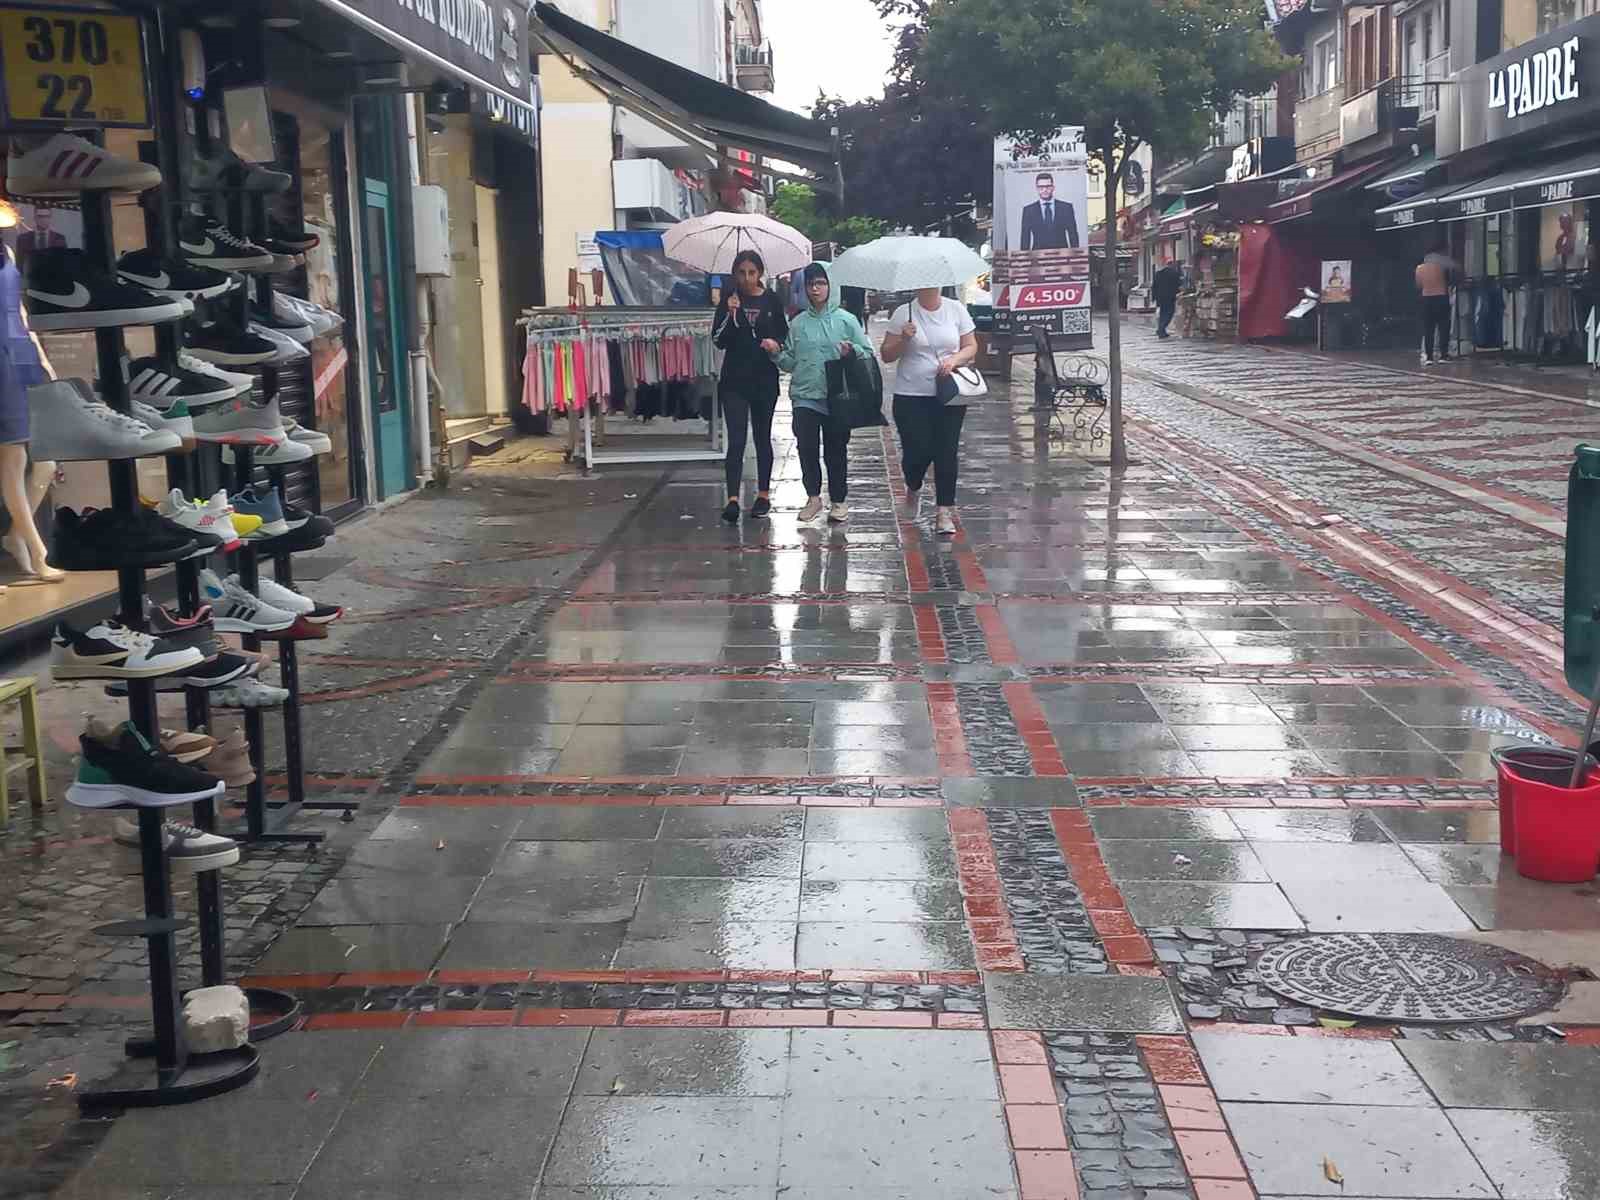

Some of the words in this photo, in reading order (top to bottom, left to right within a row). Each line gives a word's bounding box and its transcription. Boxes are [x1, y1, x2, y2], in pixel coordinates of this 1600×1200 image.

[23, 16, 109, 66] 370
[37, 74, 97, 119] 22
[1488, 69, 1506, 109] LA
[1507, 36, 1579, 119] PADRE
